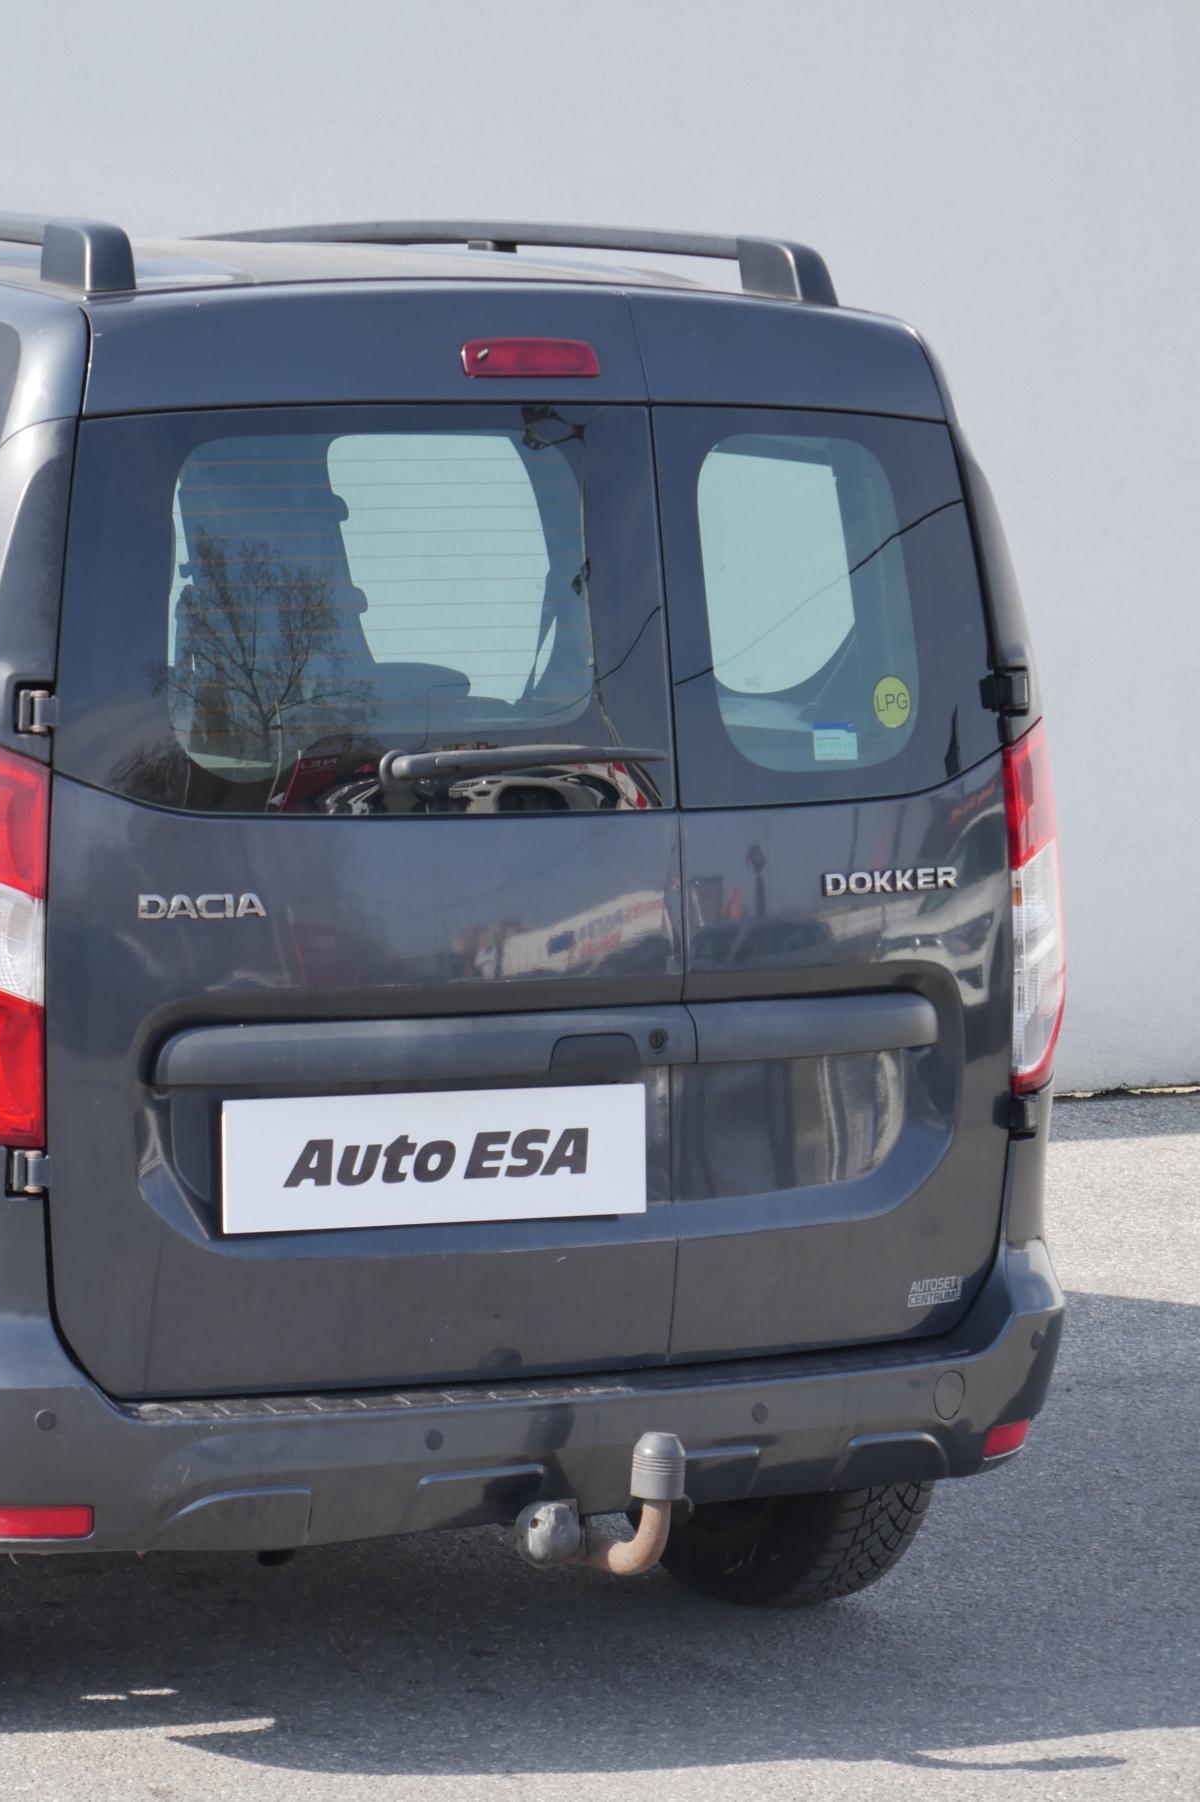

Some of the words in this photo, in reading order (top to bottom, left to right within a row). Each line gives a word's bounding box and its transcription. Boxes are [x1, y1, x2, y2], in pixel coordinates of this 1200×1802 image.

[875, 692, 909, 712] LPG
[823, 866, 959, 897] DOKKER
[137, 892, 267, 919] DACIA
[282, 1134, 456, 1188] Auto
[463, 1127, 589, 1180] ESA
[910, 1275, 957, 1293] AUTOSET
